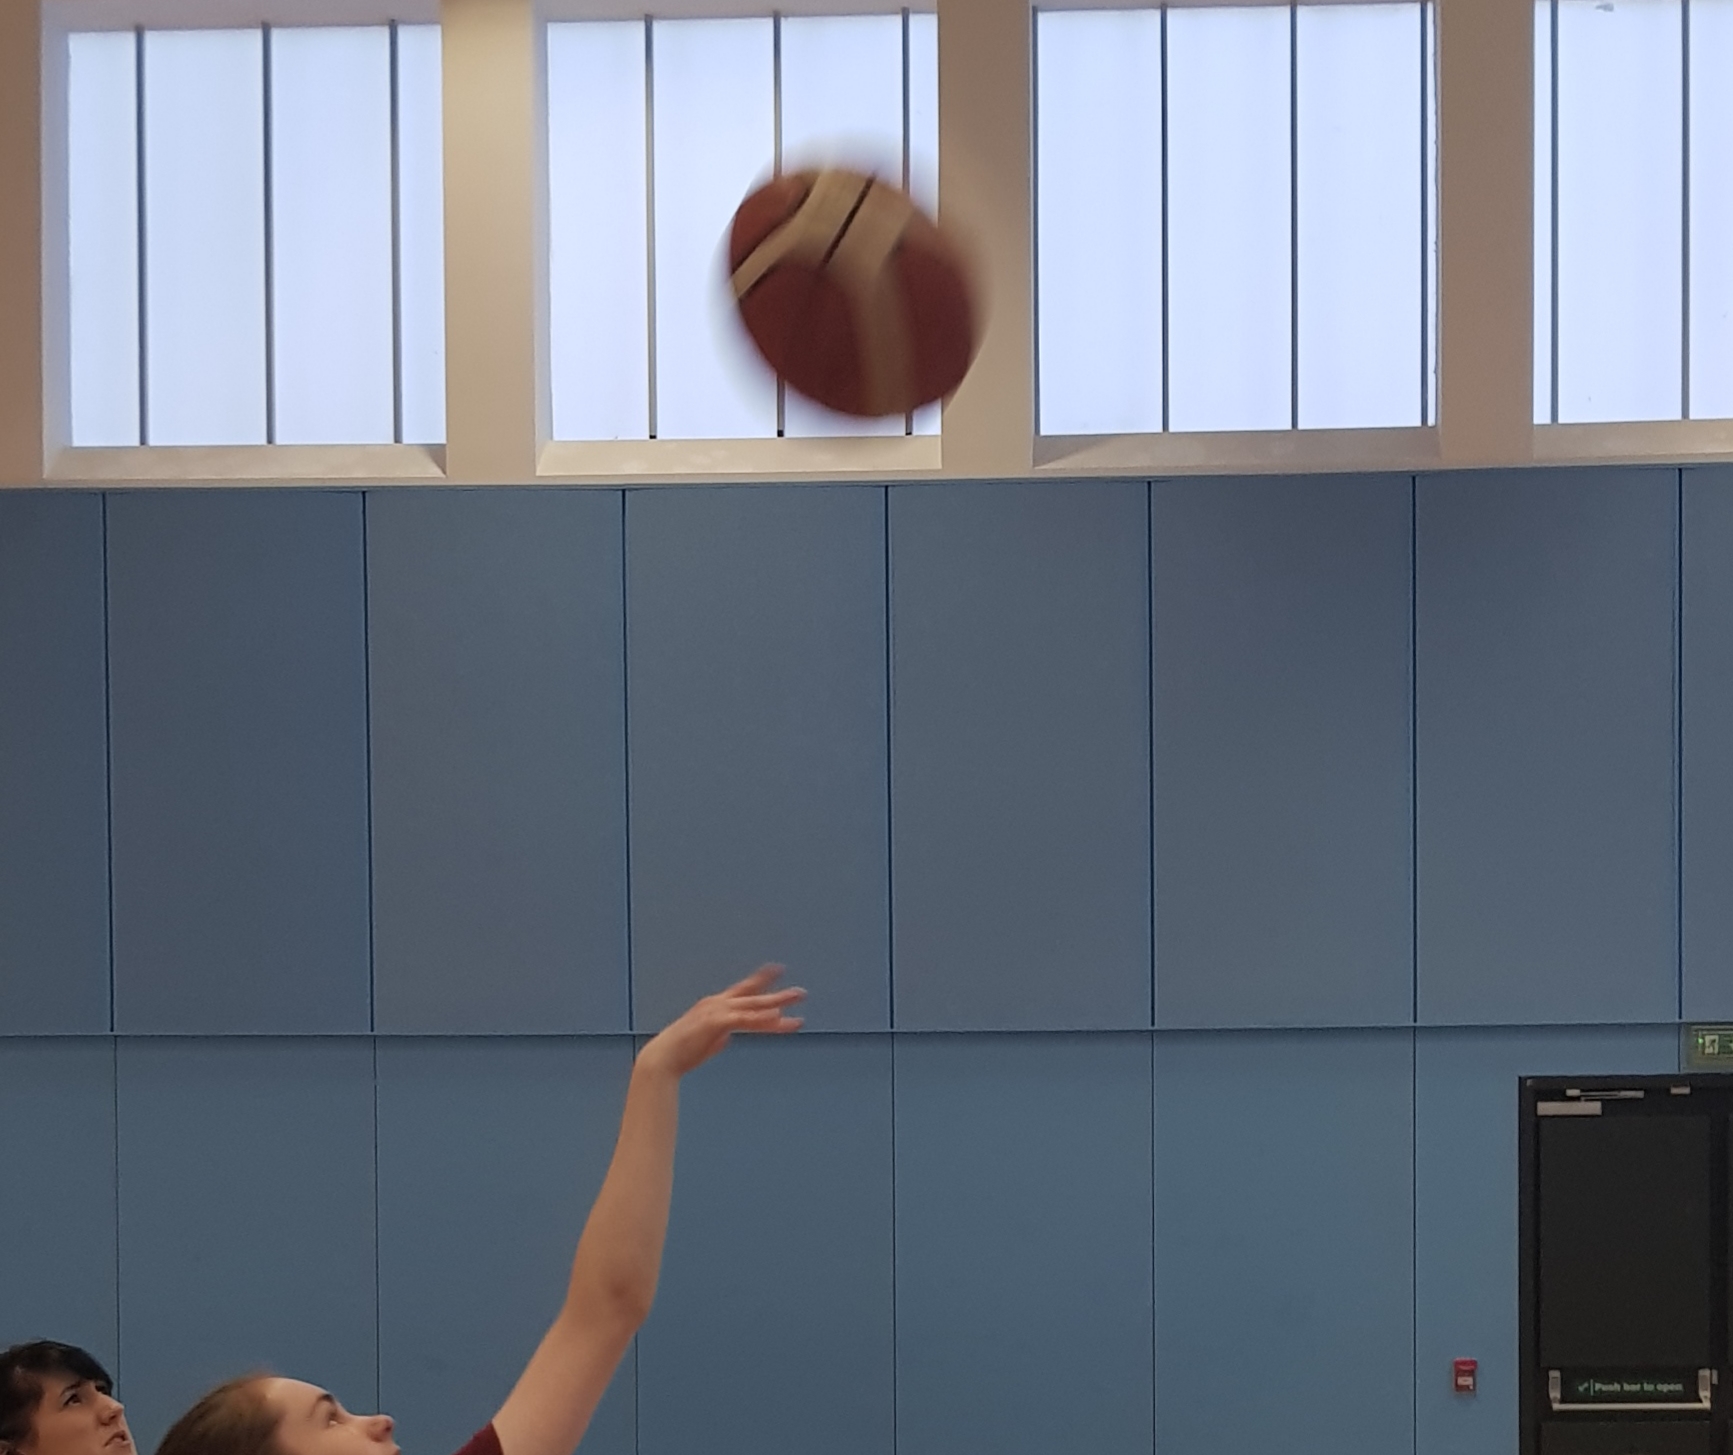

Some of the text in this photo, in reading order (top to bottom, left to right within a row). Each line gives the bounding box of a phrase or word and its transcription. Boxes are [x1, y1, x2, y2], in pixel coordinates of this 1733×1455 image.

[1594, 1382, 1621, 1392] Push
[1643, 1382, 1655, 1391] to
[1656, 1383, 1683, 1393] open
